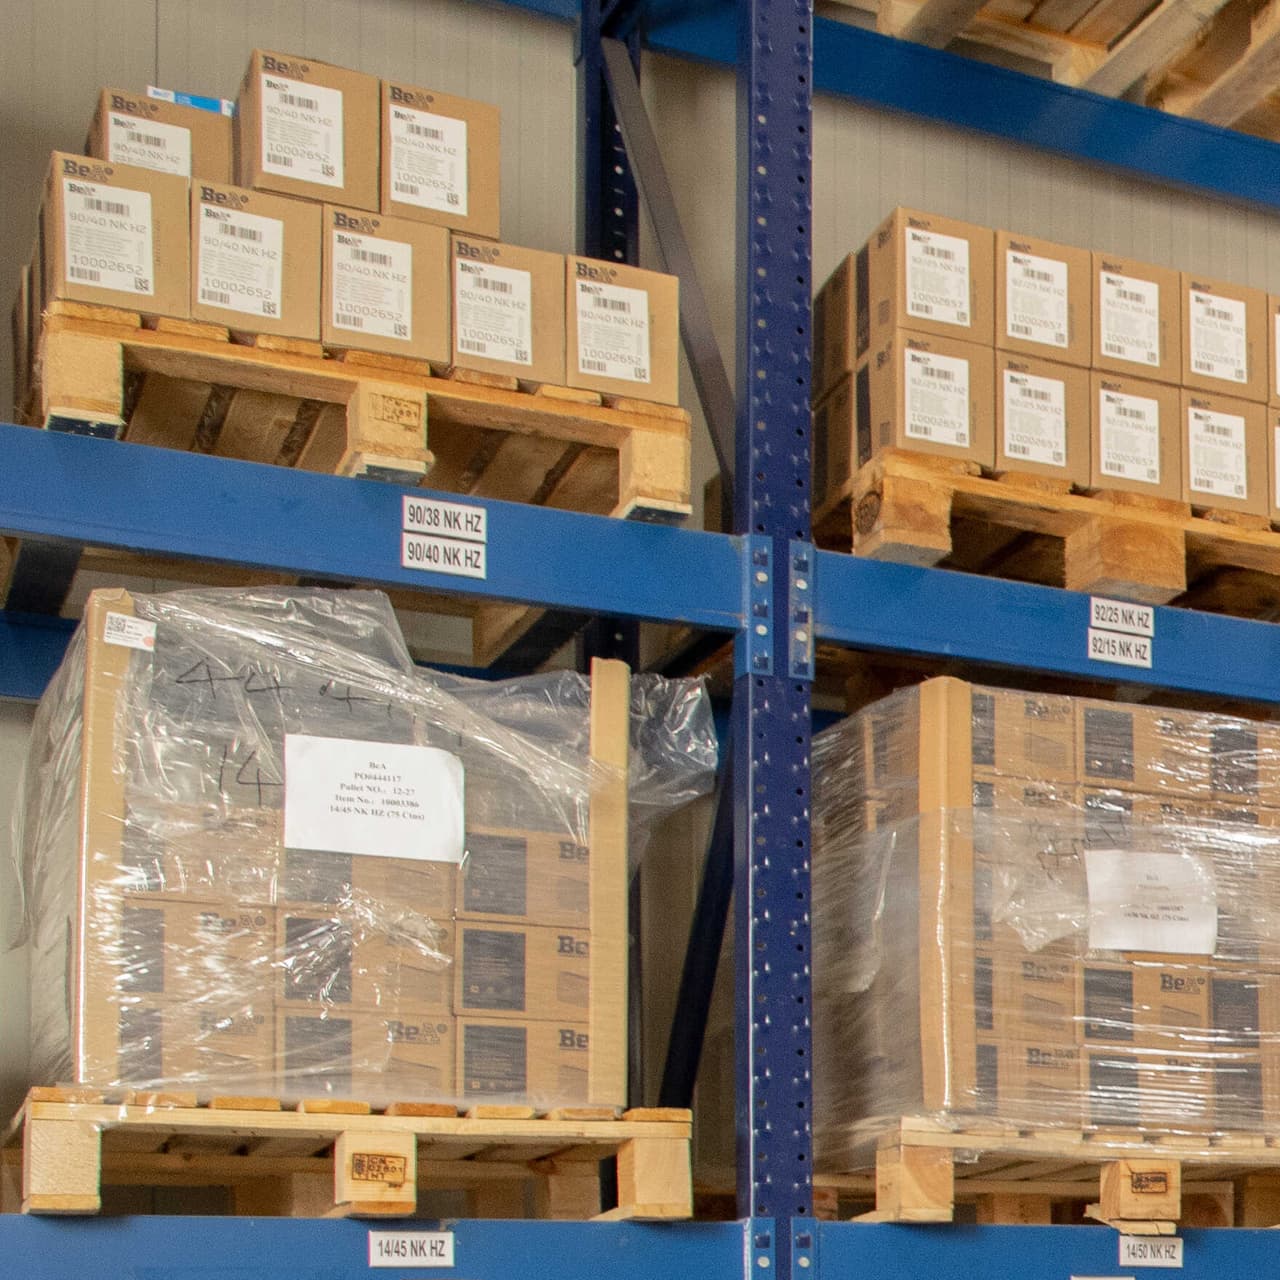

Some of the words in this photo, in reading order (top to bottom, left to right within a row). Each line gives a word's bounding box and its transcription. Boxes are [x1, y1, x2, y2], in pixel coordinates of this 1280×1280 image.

[110, 217, 128, 230] NK
[130, 222, 147, 234] HZ
[242, 243, 259, 256] NK
[261, 249, 277, 259] HZ
[375, 268, 390, 280] NK
[409, 505, 439, 526] 90/38
[444, 510, 461, 531] NK
[466, 514, 481, 533] HZ
[408, 542, 439, 563] 90/40
[443, 546, 461, 567] NK
[465, 551, 480, 568] HZ
[1095, 604, 1119, 623] 92/25
[1122, 610, 1135, 626] NK
[1137, 611, 1149, 628] HZ
[1093, 637, 1116, 655] 92/15
[1119, 640, 1132, 658] NK
[1135, 644, 1147, 660] HZ
[371, 809, 384, 817] HZ
[378, 1240, 407, 1257] 14/45
[410, 1240, 426, 1256] NK
[430, 1240, 445, 1257] HZ
[1127, 1244, 1147, 1258] 14/50
[1150, 1244, 1162, 1258] NK
[1165, 1245, 1176, 1259] HZ
